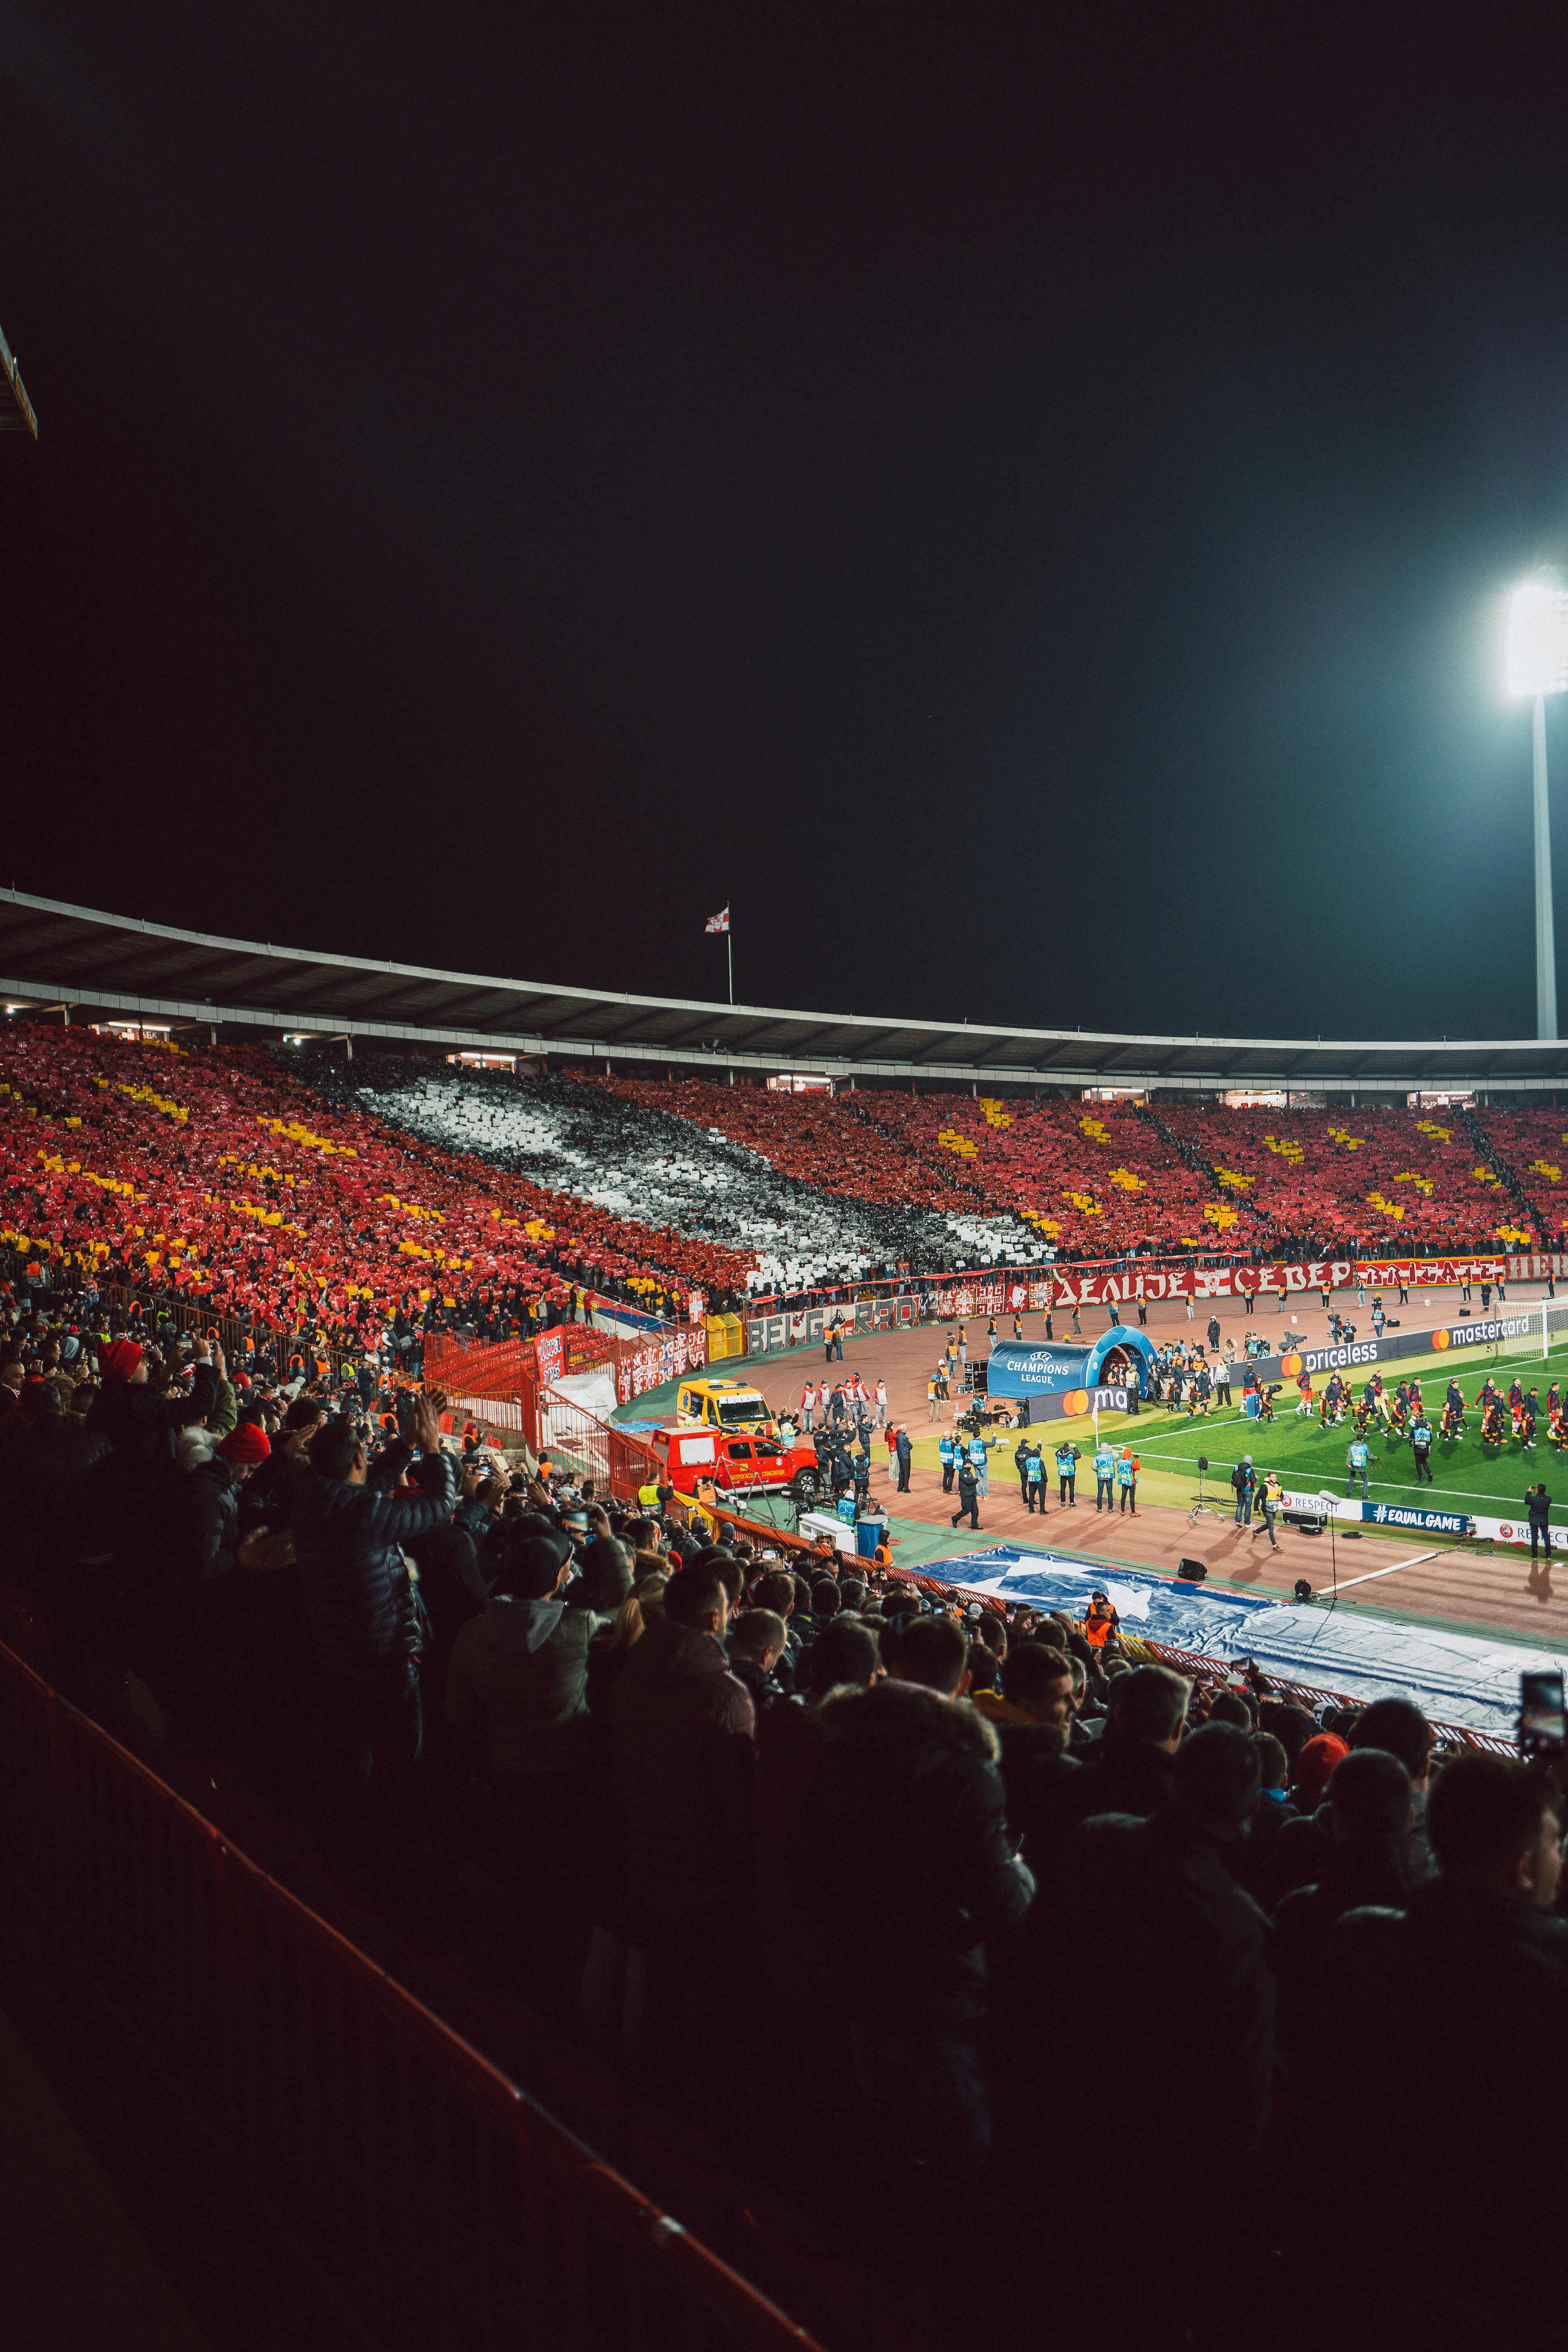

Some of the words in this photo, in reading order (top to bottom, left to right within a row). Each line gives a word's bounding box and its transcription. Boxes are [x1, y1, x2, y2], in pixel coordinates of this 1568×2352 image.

[1453, 1314, 1529, 1345] mastercard
[1030, 1352, 1051, 1362] UEFA
[1306, 1342, 1377, 1372] priceless
[1007, 1360, 1069, 1376] CHAMPIONS
[1021, 1374, 1052, 1384] LEAGUE
[1095, 1388, 1127, 1409] ma
[1518, 1528, 1568, 1544] REECT
